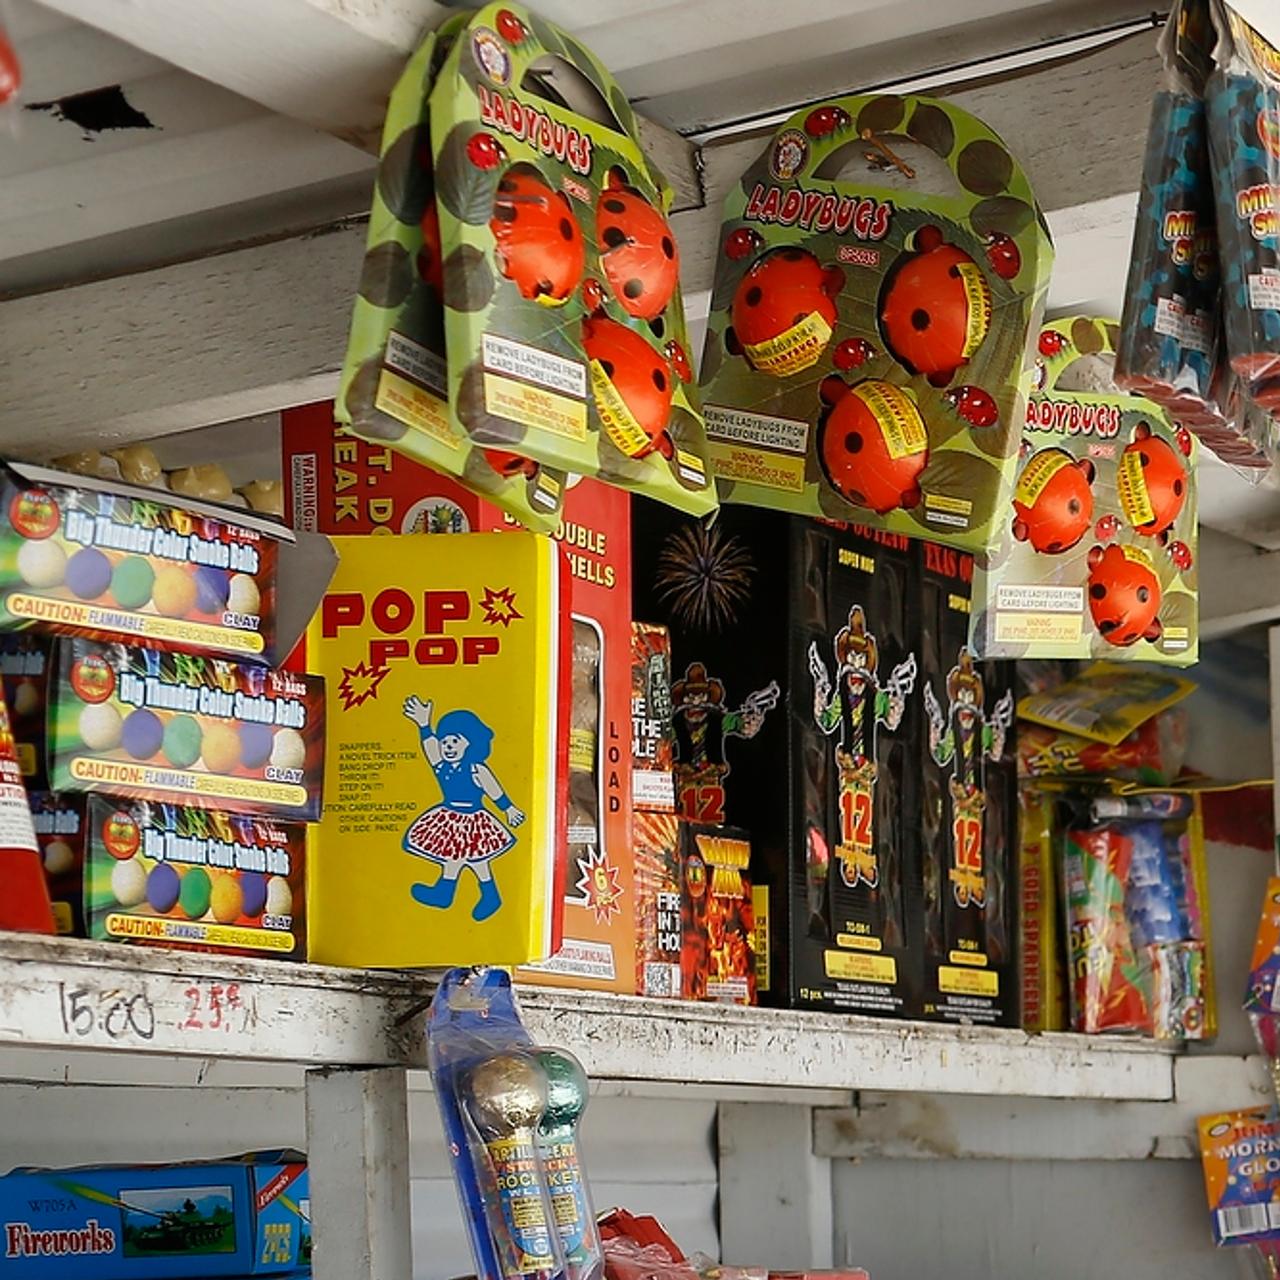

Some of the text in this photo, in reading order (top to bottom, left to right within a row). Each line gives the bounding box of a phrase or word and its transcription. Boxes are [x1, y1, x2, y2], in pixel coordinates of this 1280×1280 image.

[478, 84, 592, 176] LADYBUGS
[745, 184, 892, 241] LADYBUGS
[704, 410, 806, 437] REMOVE LADYBUGS FROM
[706, 422, 727, 436] CARD
[728, 427, 760, 442] BEFORE
[1024, 399, 1122, 438] ADYBUGS
[64, 508, 259, 575] Big Thunder Color Smoke Balls
[554, 524, 606, 555] OUBLE
[567, 553, 616, 588] HELLS
[88, 611, 145, 634] FLAMMABLE
[222, 612, 260, 631] CLAY
[322, 588, 470, 639] POP
[370, 637, 500, 668] POP
[119, 672, 306, 729] Big Thunder Color Smoke Balls
[144, 771, 196, 790] FLAMMABLE
[265, 767, 303, 784] CLAY
[682, 787, 726, 822] 12
[840, 789, 873, 848] 12
[144, 827, 290, 876] Big Thunder Color Smoke Balls
[953, 818, 982, 872] 12
[594, 866, 608, 893] 6
[262, 913, 292, 930] CLAY
[5, 1219, 116, 1257] Fireworks
